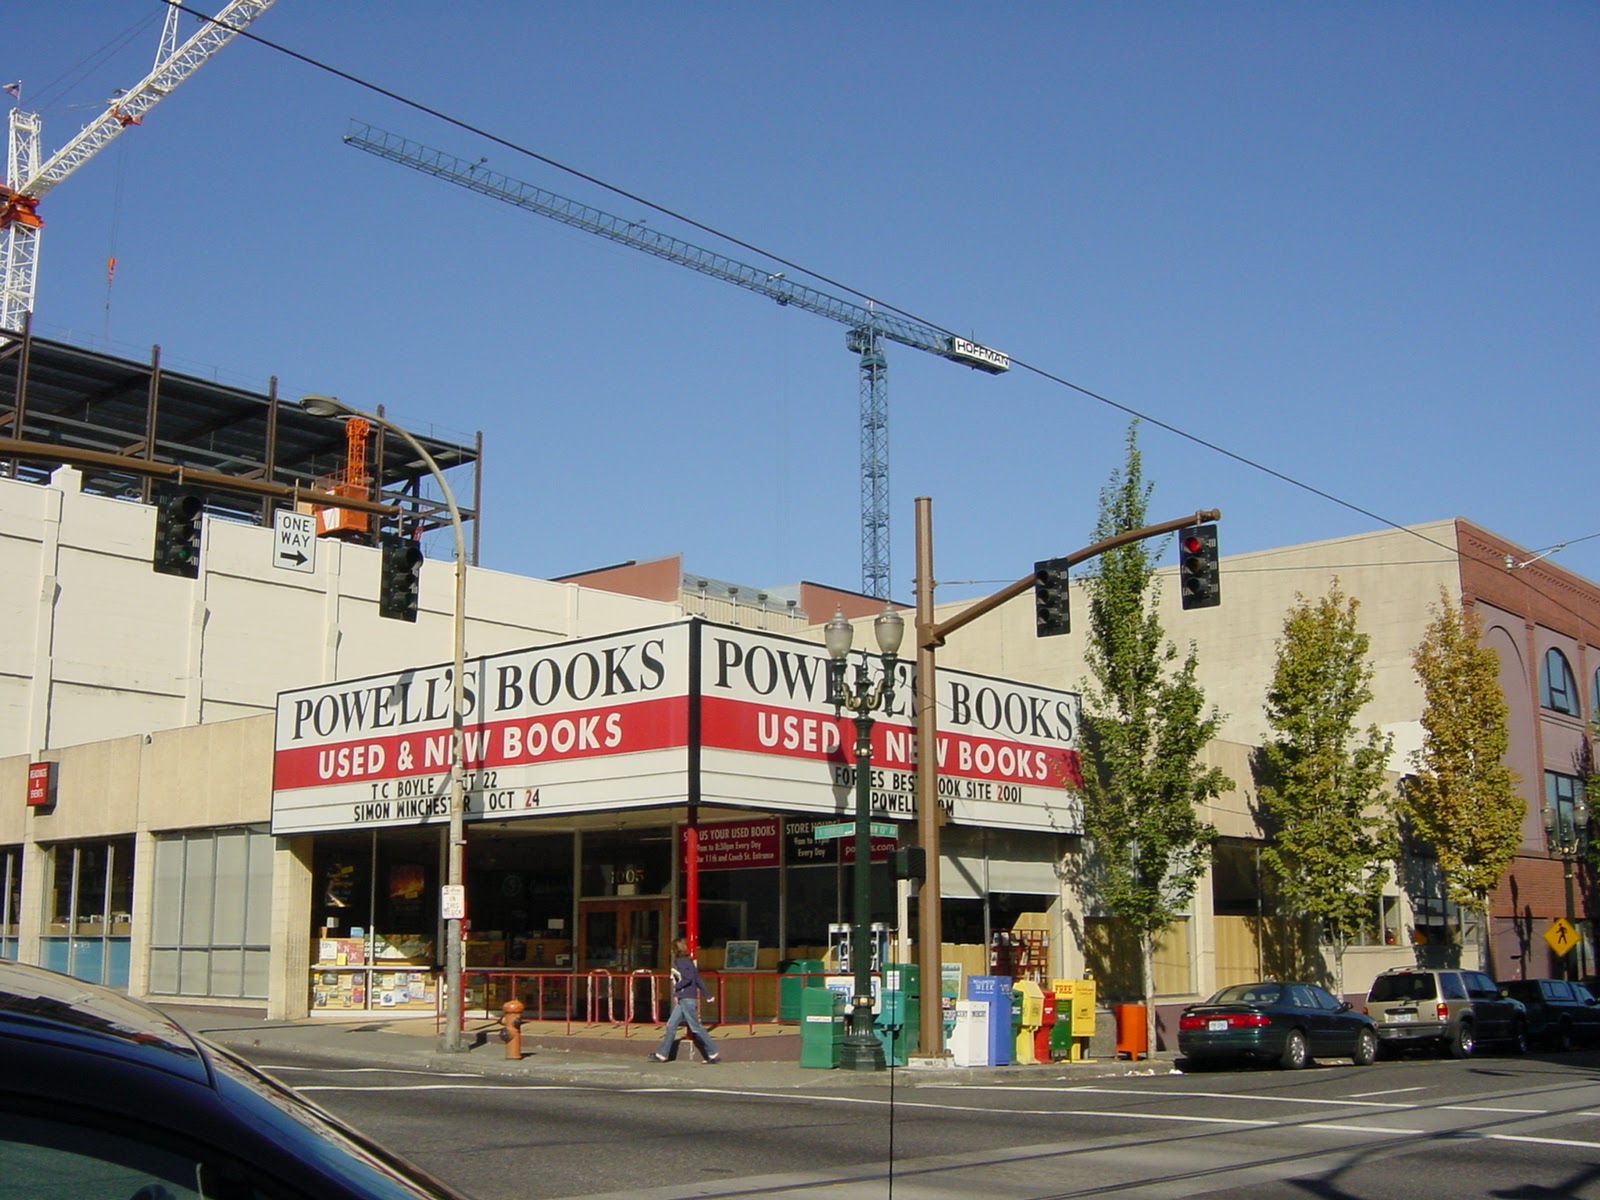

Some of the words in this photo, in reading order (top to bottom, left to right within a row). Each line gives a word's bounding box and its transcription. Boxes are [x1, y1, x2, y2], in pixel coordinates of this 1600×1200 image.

[957, 340, 1008, 366] HOFFMAN
[282, 516, 310, 533] ONE
[281, 531, 310, 548] WAY
[292, 668, 476, 740] POWELL'S
[495, 639, 664, 713] BOOKS
[949, 681, 1072, 742] BOOKS
[318, 744, 385, 780] USED
[397, 742, 414, 770] &
[503, 712, 622, 760] BOOKS
[758, 711, 840, 754] USED
[960, 741, 1048, 780] BOOKS
[397, 778, 434, 796] BOYLE
[484, 771, 498, 789] 22
[893, 773, 919, 793] BES
[938, 778, 961, 797] OOK
[966, 781, 992, 800] SITE
[997, 785, 1022, 803] 2001
[353, 803, 391, 822] SIMON
[489, 791, 515, 811] OCT
[525, 788, 540, 808] 24
[710, 828, 730, 840] YOUR
[731, 827, 750, 839] USED
[751, 825, 776, 837] BOOKS
[786, 822, 810, 835] STORE
[1055, 984, 1073, 994] FREE
